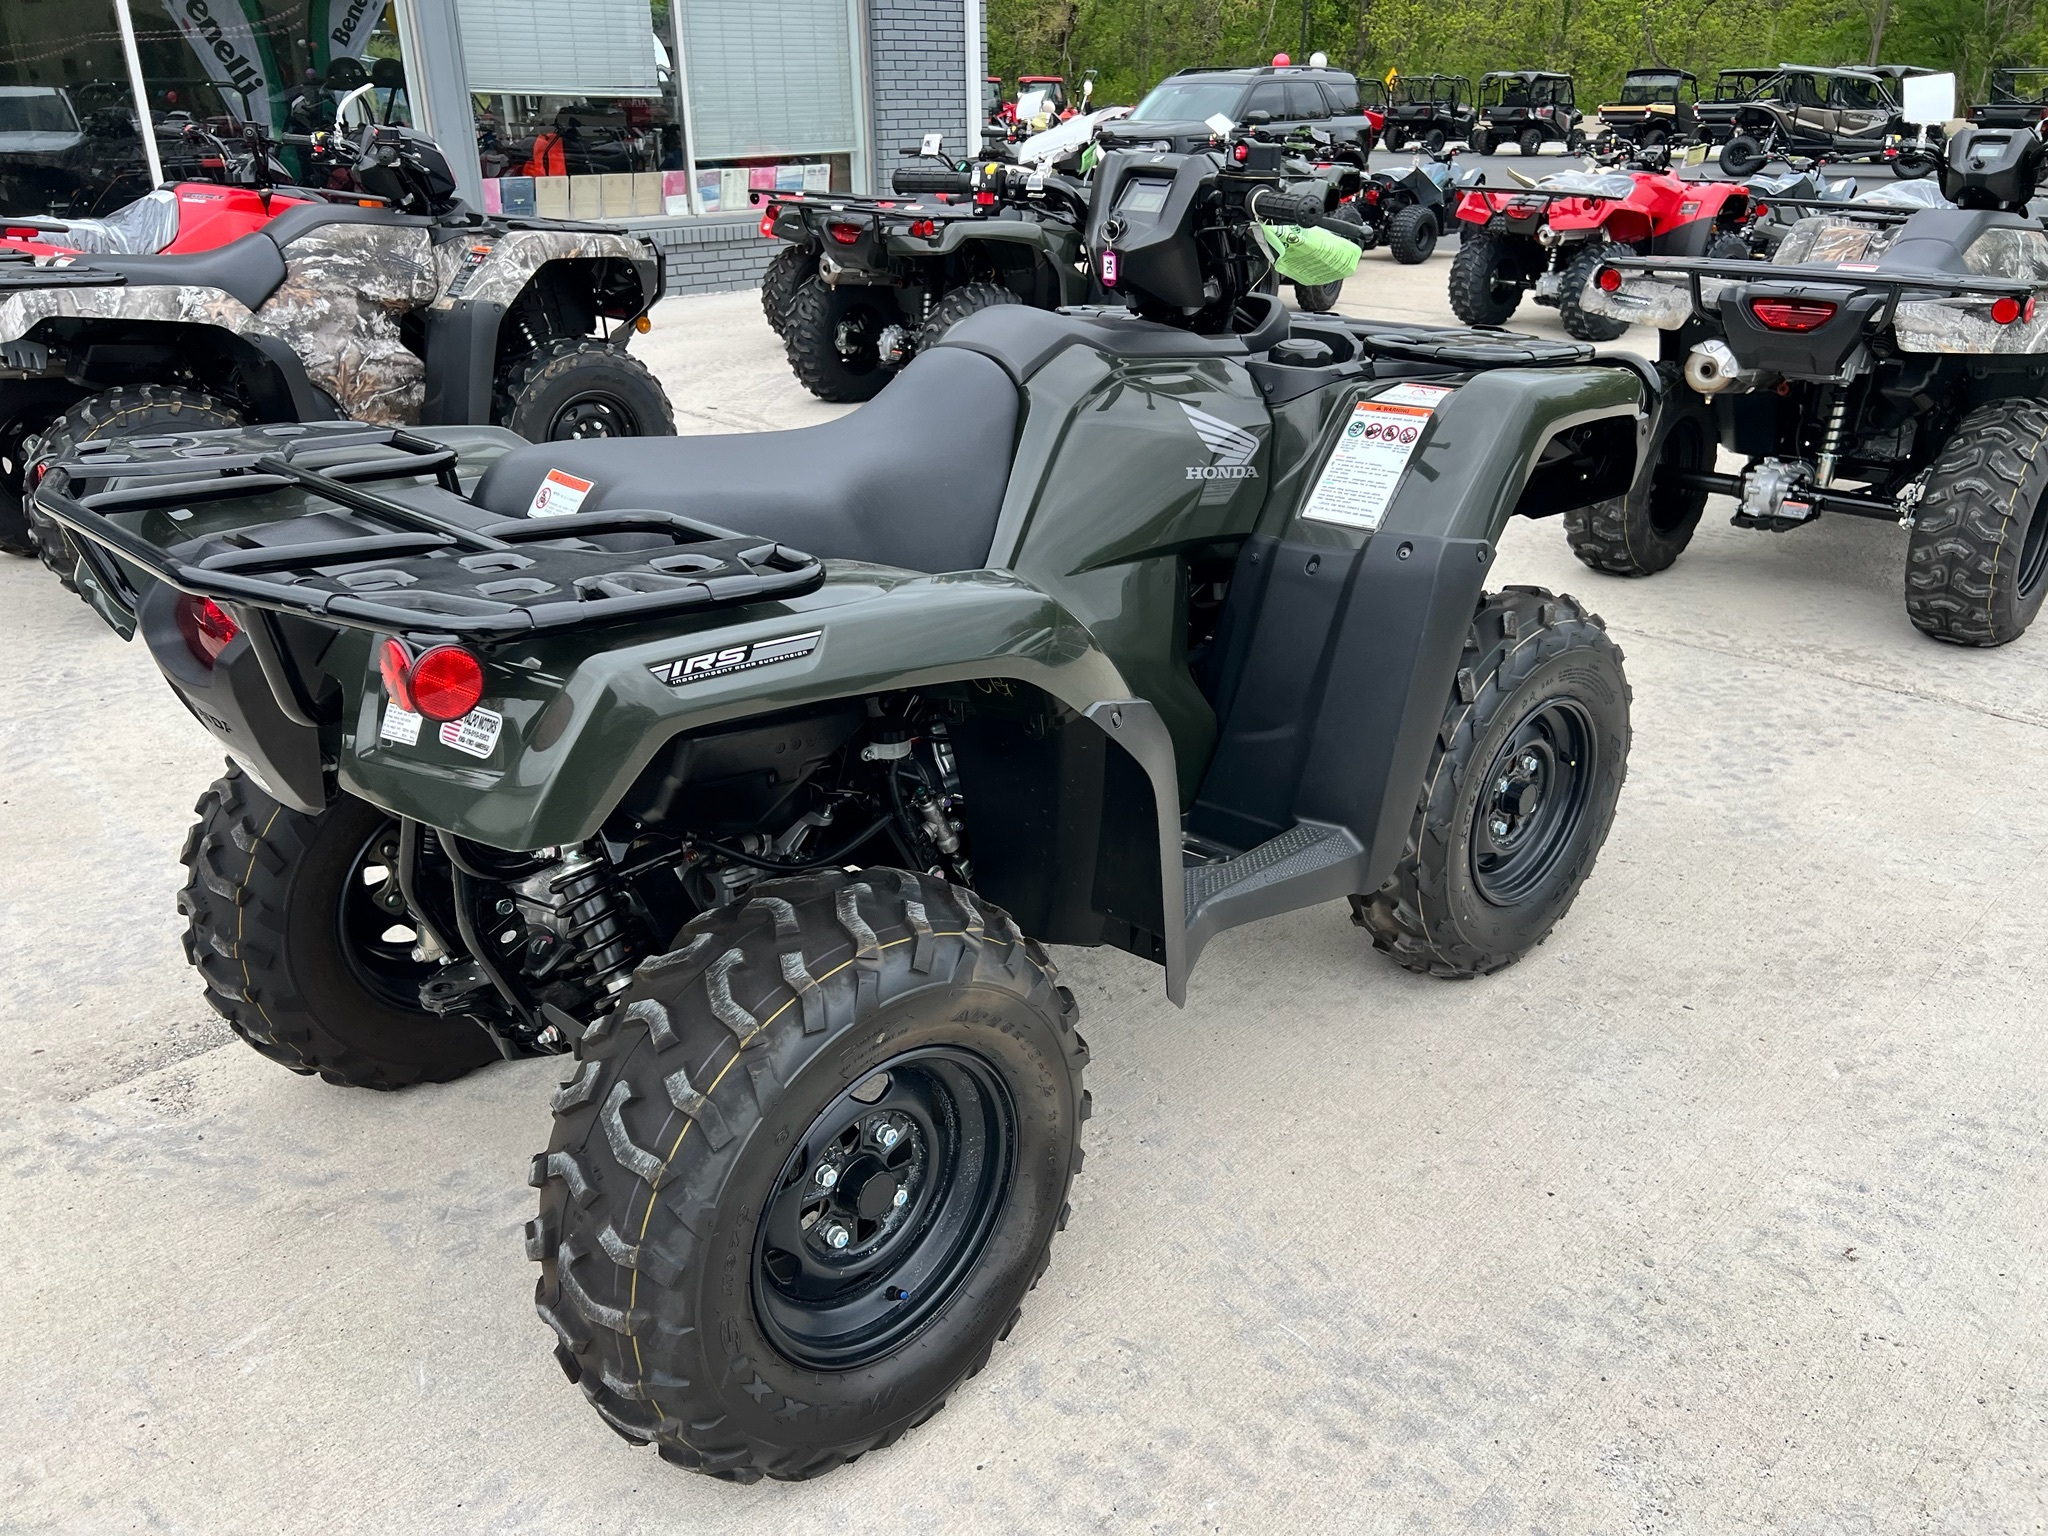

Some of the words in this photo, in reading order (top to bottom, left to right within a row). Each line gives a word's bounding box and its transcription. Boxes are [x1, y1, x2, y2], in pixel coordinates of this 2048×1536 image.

[1185, 466, 1259, 480] HONDA
[671, 645, 748, 678] IRS
[672, 666, 733, 685] INDEPENDENT
[734, 661, 757, 671] REAR
[758, 650, 808, 665] SUSPENSION
